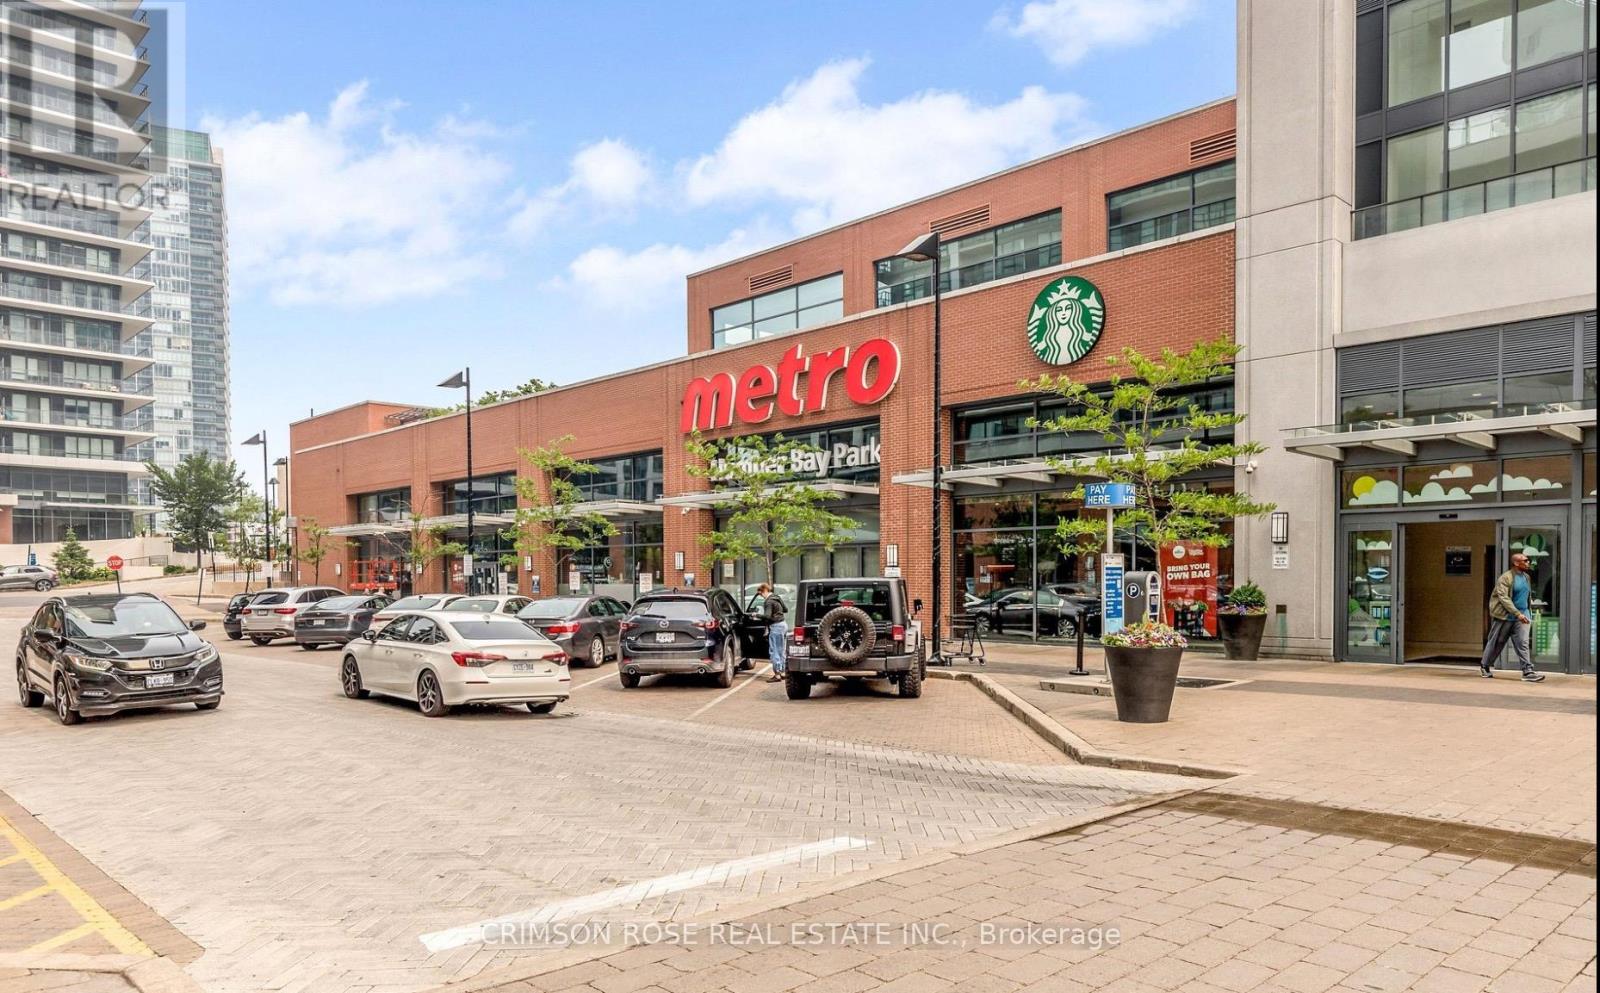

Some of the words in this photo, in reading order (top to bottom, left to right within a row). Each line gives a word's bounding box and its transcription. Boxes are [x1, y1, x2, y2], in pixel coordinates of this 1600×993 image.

[681, 338, 902, 433] metro
[790, 449, 832, 478] Bay
[834, 437, 880, 468] Park
[1090, 485, 1107, 495] PAY
[1087, 495, 1111, 505] HERE
[107, 559, 123, 567] STOP
[1189, 563, 1211, 571] YOUR
[1166, 571, 1190, 580] OWN
[1191, 570, 1211, 579] BAG
[1130, 586, 1138, 596] P
